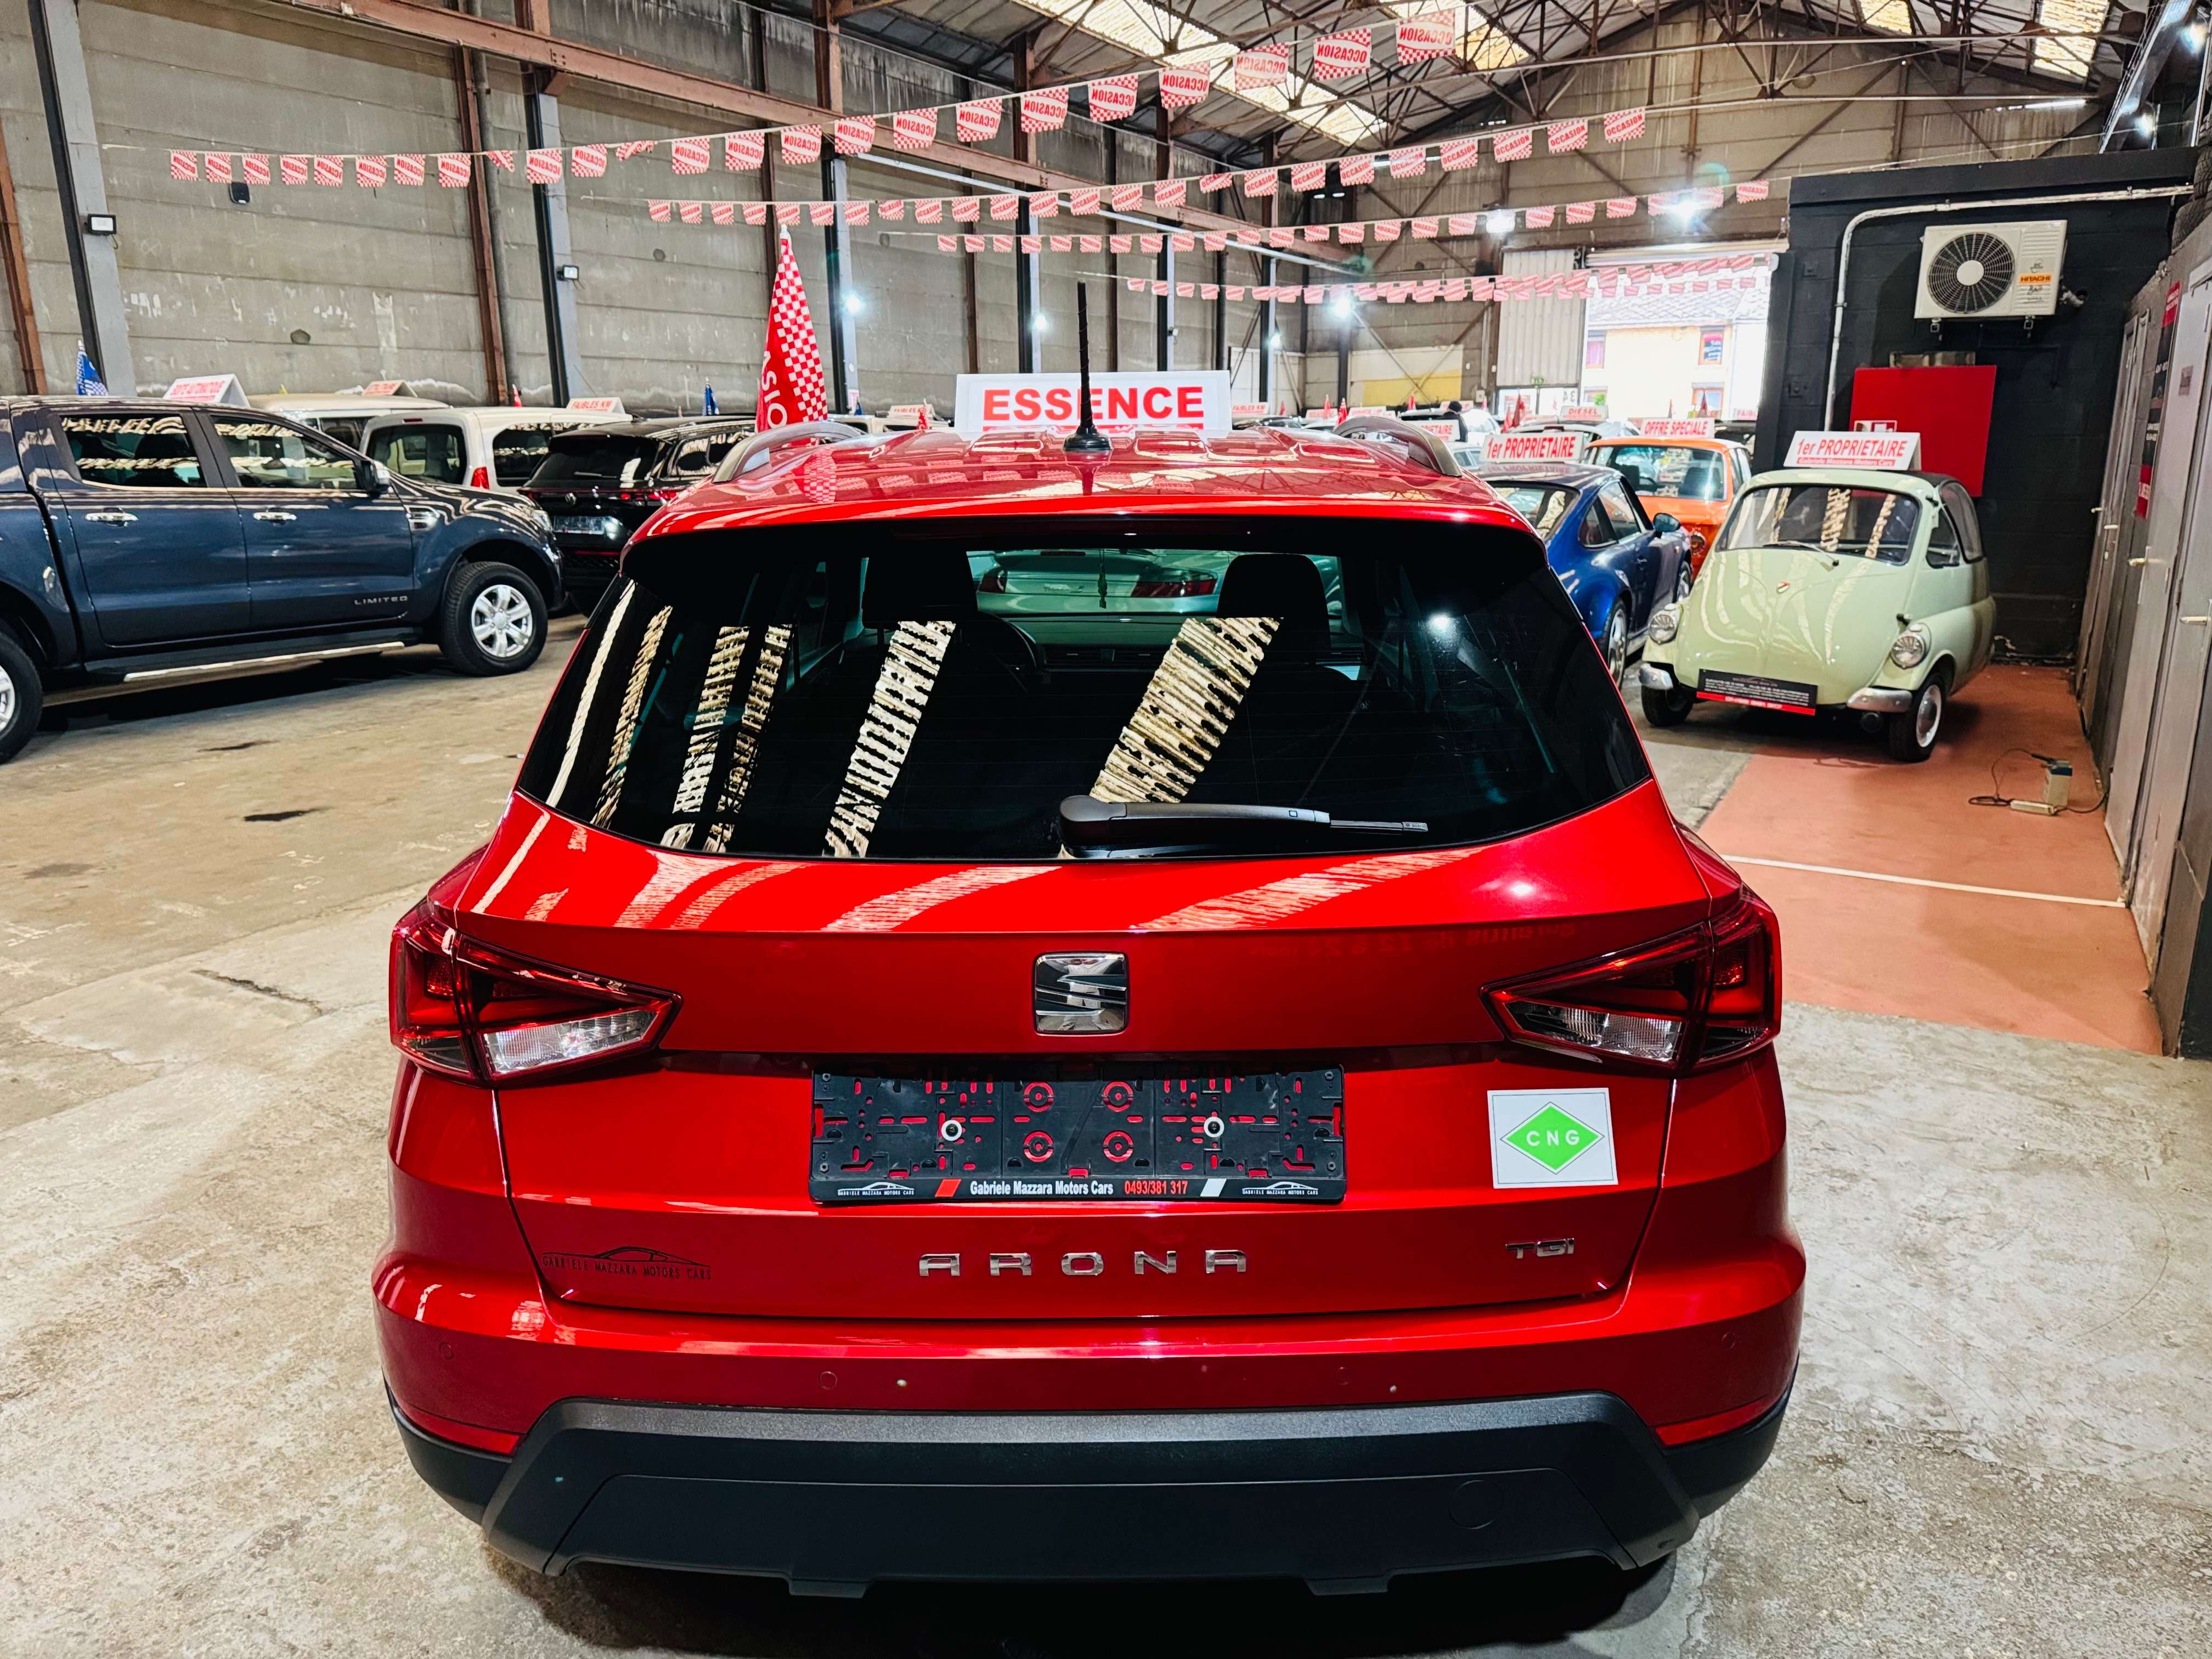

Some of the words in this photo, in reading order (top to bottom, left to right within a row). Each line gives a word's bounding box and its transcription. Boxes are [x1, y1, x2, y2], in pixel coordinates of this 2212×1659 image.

[1606, 114, 1643, 137] OCCASION
[1496, 134, 1530, 155] OCCASION
[1550, 125, 1585, 146] OCCASION
[1442, 144, 1475, 165] OCCASION
[1293, 167, 1323, 186] OCCASION
[1341, 161, 1371, 179] OCCASIO
[1246, 173, 1276, 192] OCCASION
[1072, 194, 1098, 209] OCCASION
[1114, 190, 1141, 206] OCCASION
[1156, 185, 1184, 202] OCCASION
[1031, 198, 1057, 212] OCCASION
[983, 386, 1205, 421] ESSENCE
[1644, 421, 1669, 435] OFFRE
[1670, 421, 1708, 436] SPECIALE
[1487, 438, 1503, 459] 1er
[1504, 436, 1576, 458] PROPRIETAIRE
[1797, 439, 1815, 455] 1er
[1816, 439, 1907, 456] PROPRIETAIRE
[354, 595, 409, 606] LIMITED
[1526, 1129, 1580, 1147] CNG
[970, 1181, 1011, 1195] Gabriele
[1013, 1181, 1053, 1195] Mazzara
[1054, 1181, 1089, 1195] Motors
[1091, 1181, 1114, 1195] Cars
[1125, 1180, 1167, 1194] 0493/381
[1170, 1180, 1188, 1194] 317
[1505, 1237, 1575, 1260] TGI
[541, 1255, 589, 1271] GABRIELE
[594, 1262, 637, 1275] MAZZARA
[643, 1266, 680, 1278] MOTORS
[687, 1268, 712, 1280] CARS
[918, 1249, 1247, 1277] ARONA
